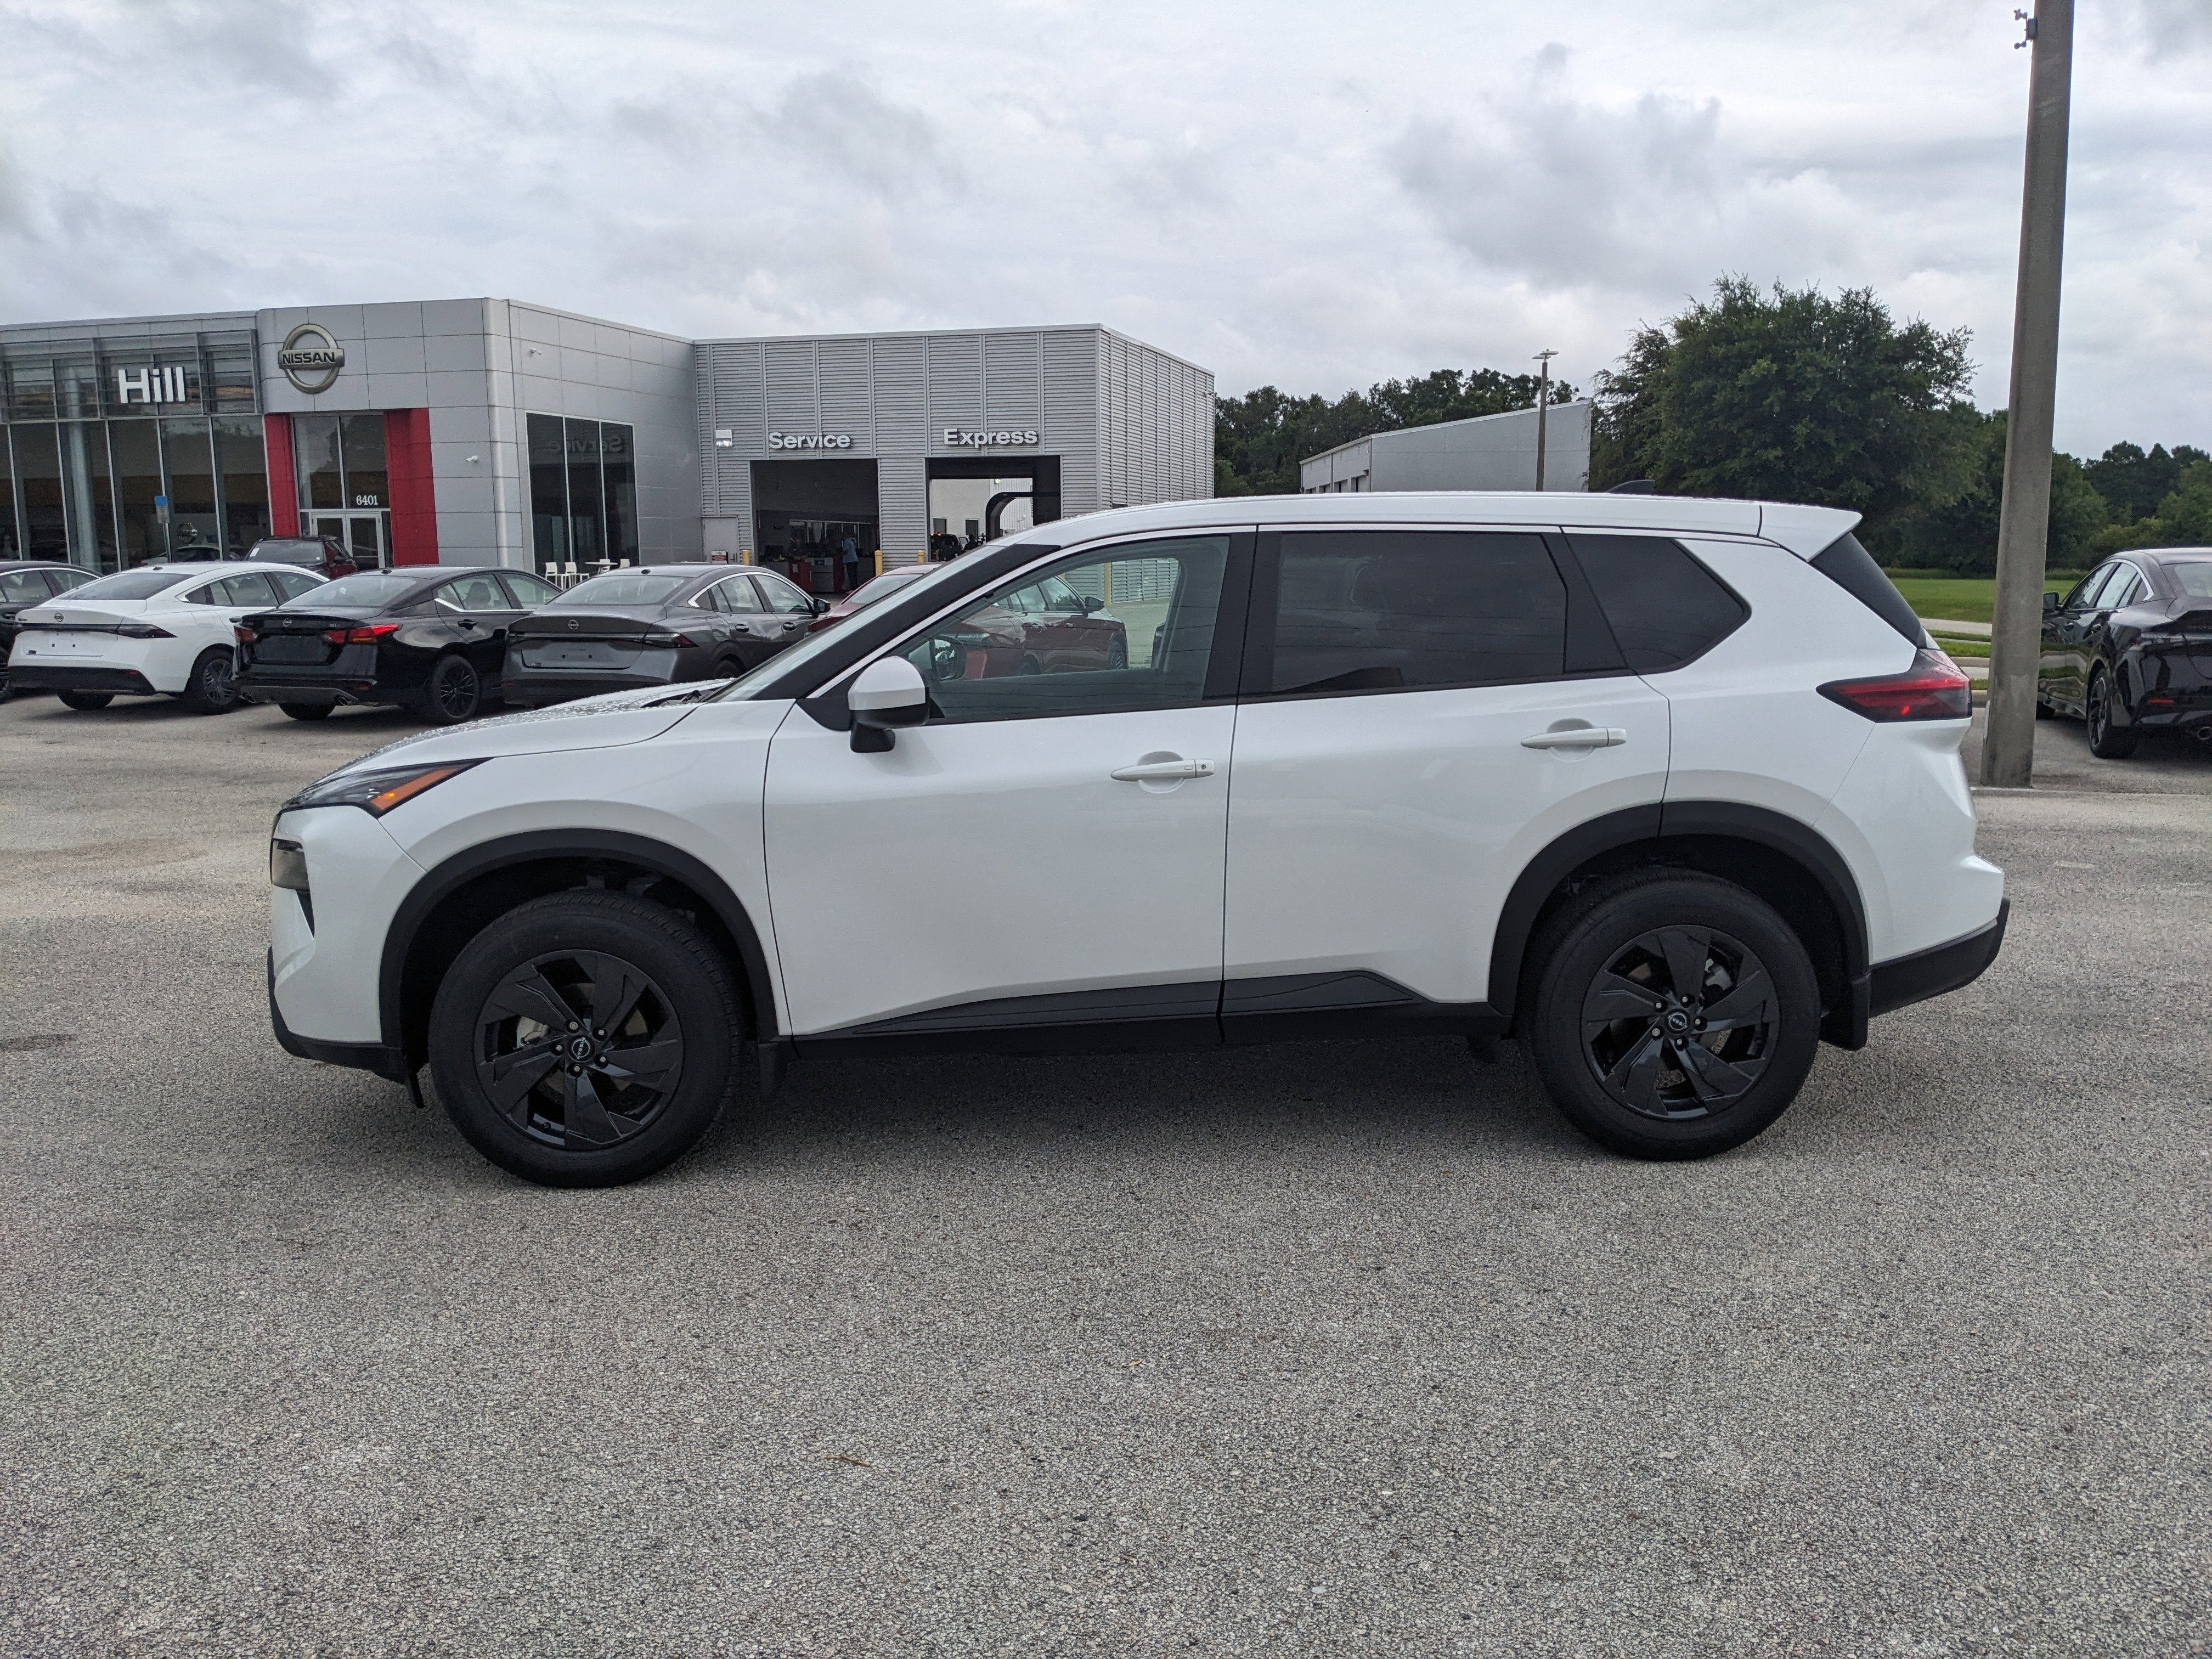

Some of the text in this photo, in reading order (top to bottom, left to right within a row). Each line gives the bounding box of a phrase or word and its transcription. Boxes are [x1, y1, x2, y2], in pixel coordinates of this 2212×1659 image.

[283, 352, 335, 364] NISSAN
[118, 366, 185, 404] Hill
[769, 432, 851, 449] Service
[944, 428, 1038, 449] Express
[356, 494, 379, 505] 6401
